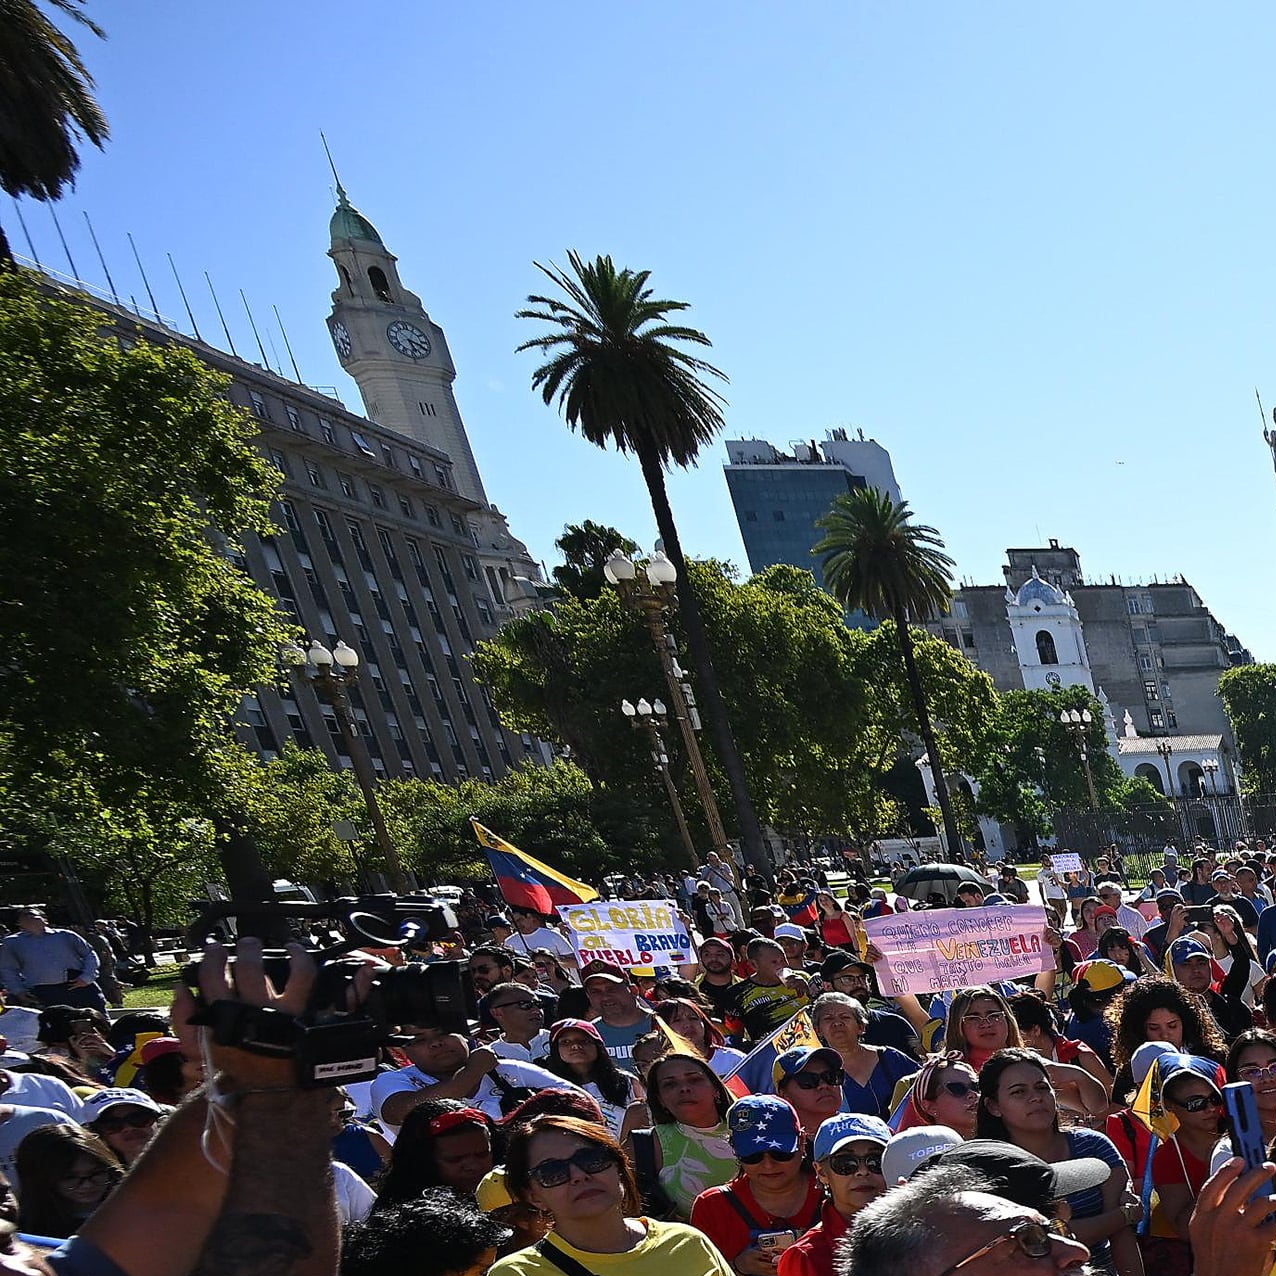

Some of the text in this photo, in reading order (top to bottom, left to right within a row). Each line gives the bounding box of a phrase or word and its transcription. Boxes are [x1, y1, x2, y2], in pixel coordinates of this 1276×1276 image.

[634, 933, 691, 952] BRAVO
[935, 934, 1042, 961] VENEZUELA
[578, 949, 653, 966] PUEBLO
[894, 960, 924, 976] QUE
